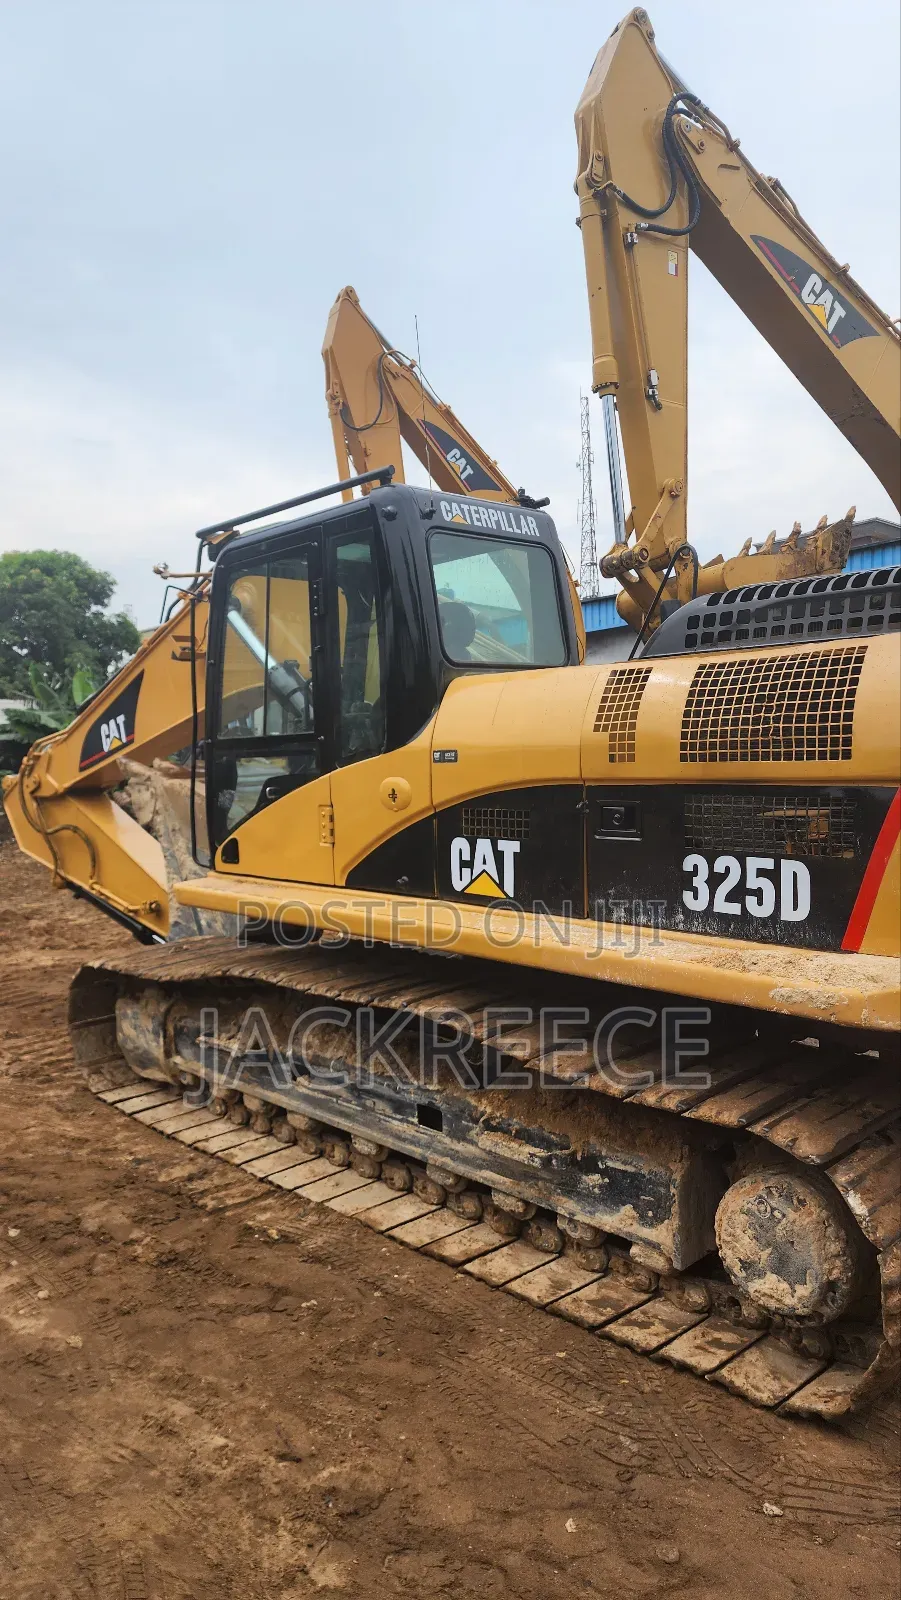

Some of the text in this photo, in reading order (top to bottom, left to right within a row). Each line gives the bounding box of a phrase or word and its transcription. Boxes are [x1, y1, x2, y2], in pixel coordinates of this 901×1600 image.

[801, 273, 847, 335] CAT
[446, 448, 474, 481] CAT
[440, 500, 540, 537] CATERPILLAR
[100, 713, 127, 753] CAT
[450, 836, 521, 899] CAT
[682, 853, 811, 922] 325D
